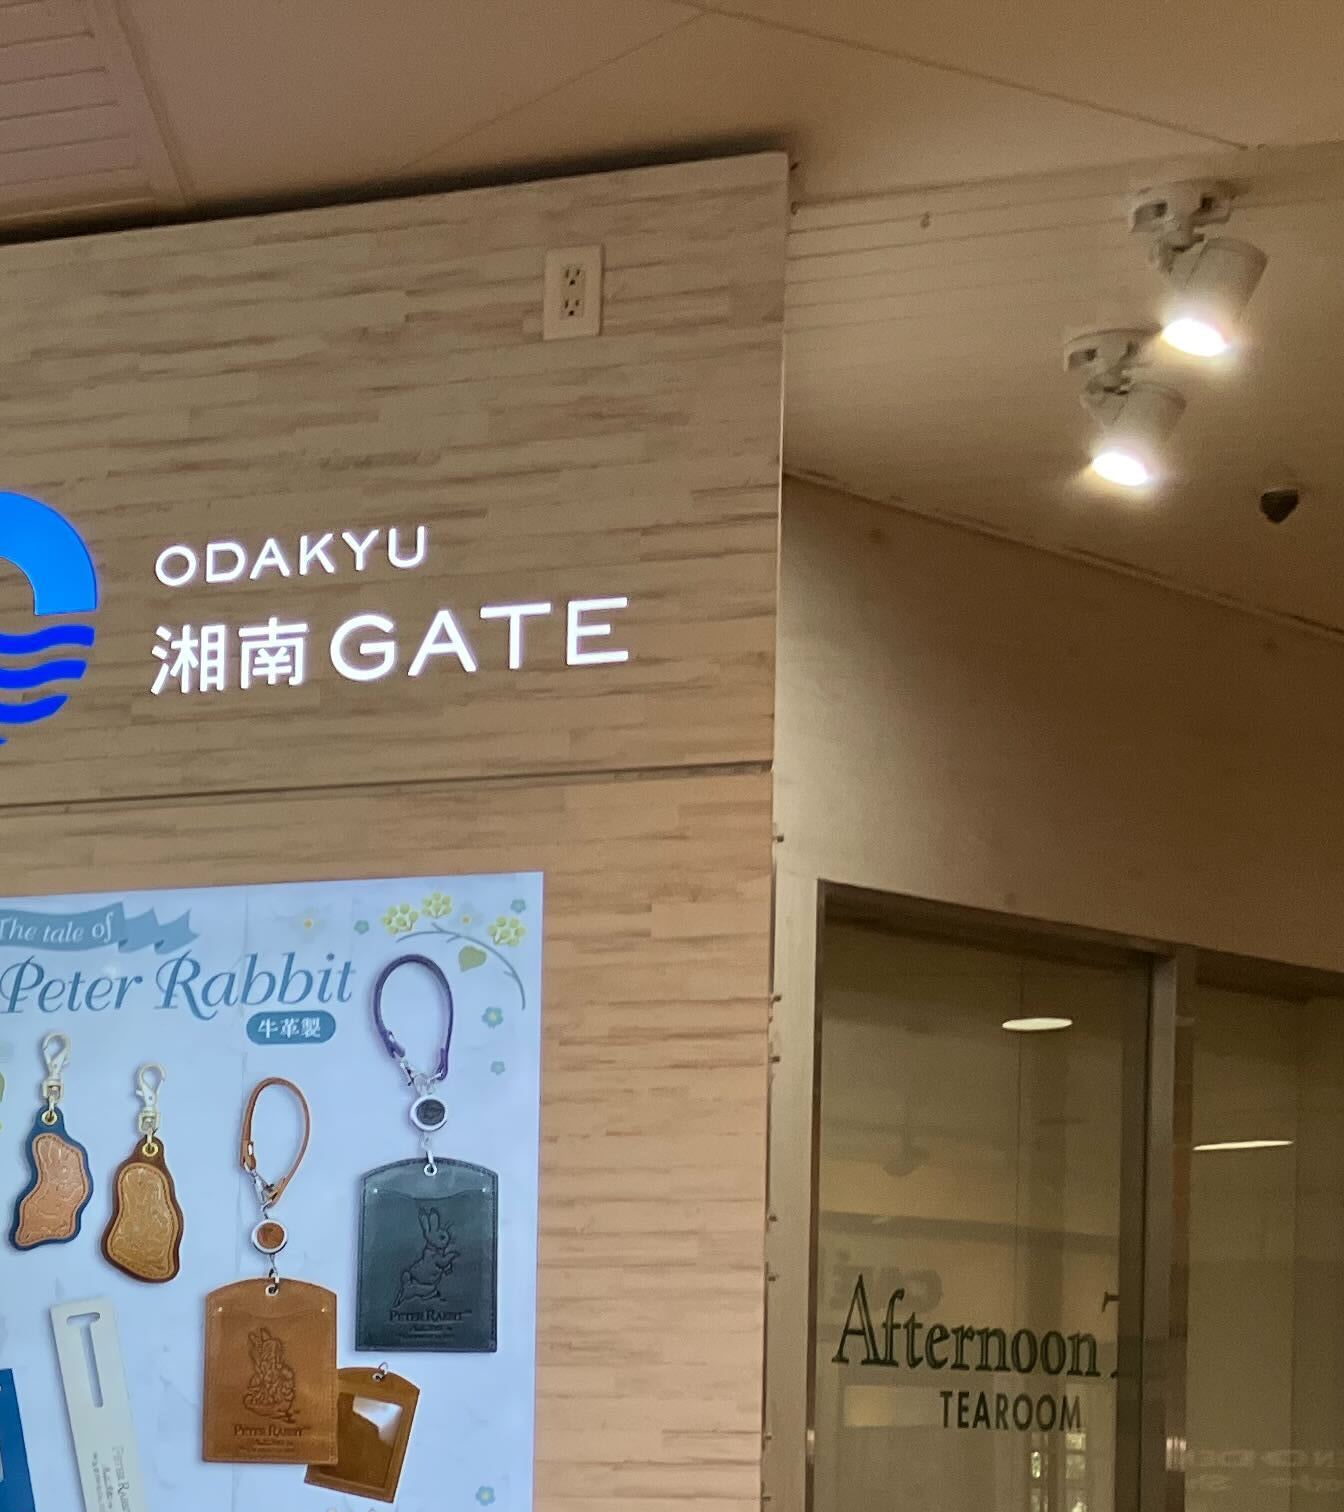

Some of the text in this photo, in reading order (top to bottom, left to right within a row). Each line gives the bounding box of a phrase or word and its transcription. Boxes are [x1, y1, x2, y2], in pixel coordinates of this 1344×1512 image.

[153, 525, 429, 588] ODAKYU
[43, 920, 85, 943] tale
[91, 911, 114, 944] of
[0, 950, 354, 1021] Peter Rabbit
[257, 1016, 322, 1040] 牛革製
[831, 1273, 1101, 1379] Afternoon
[938, 1390, 1082, 1432] TEAROOM
